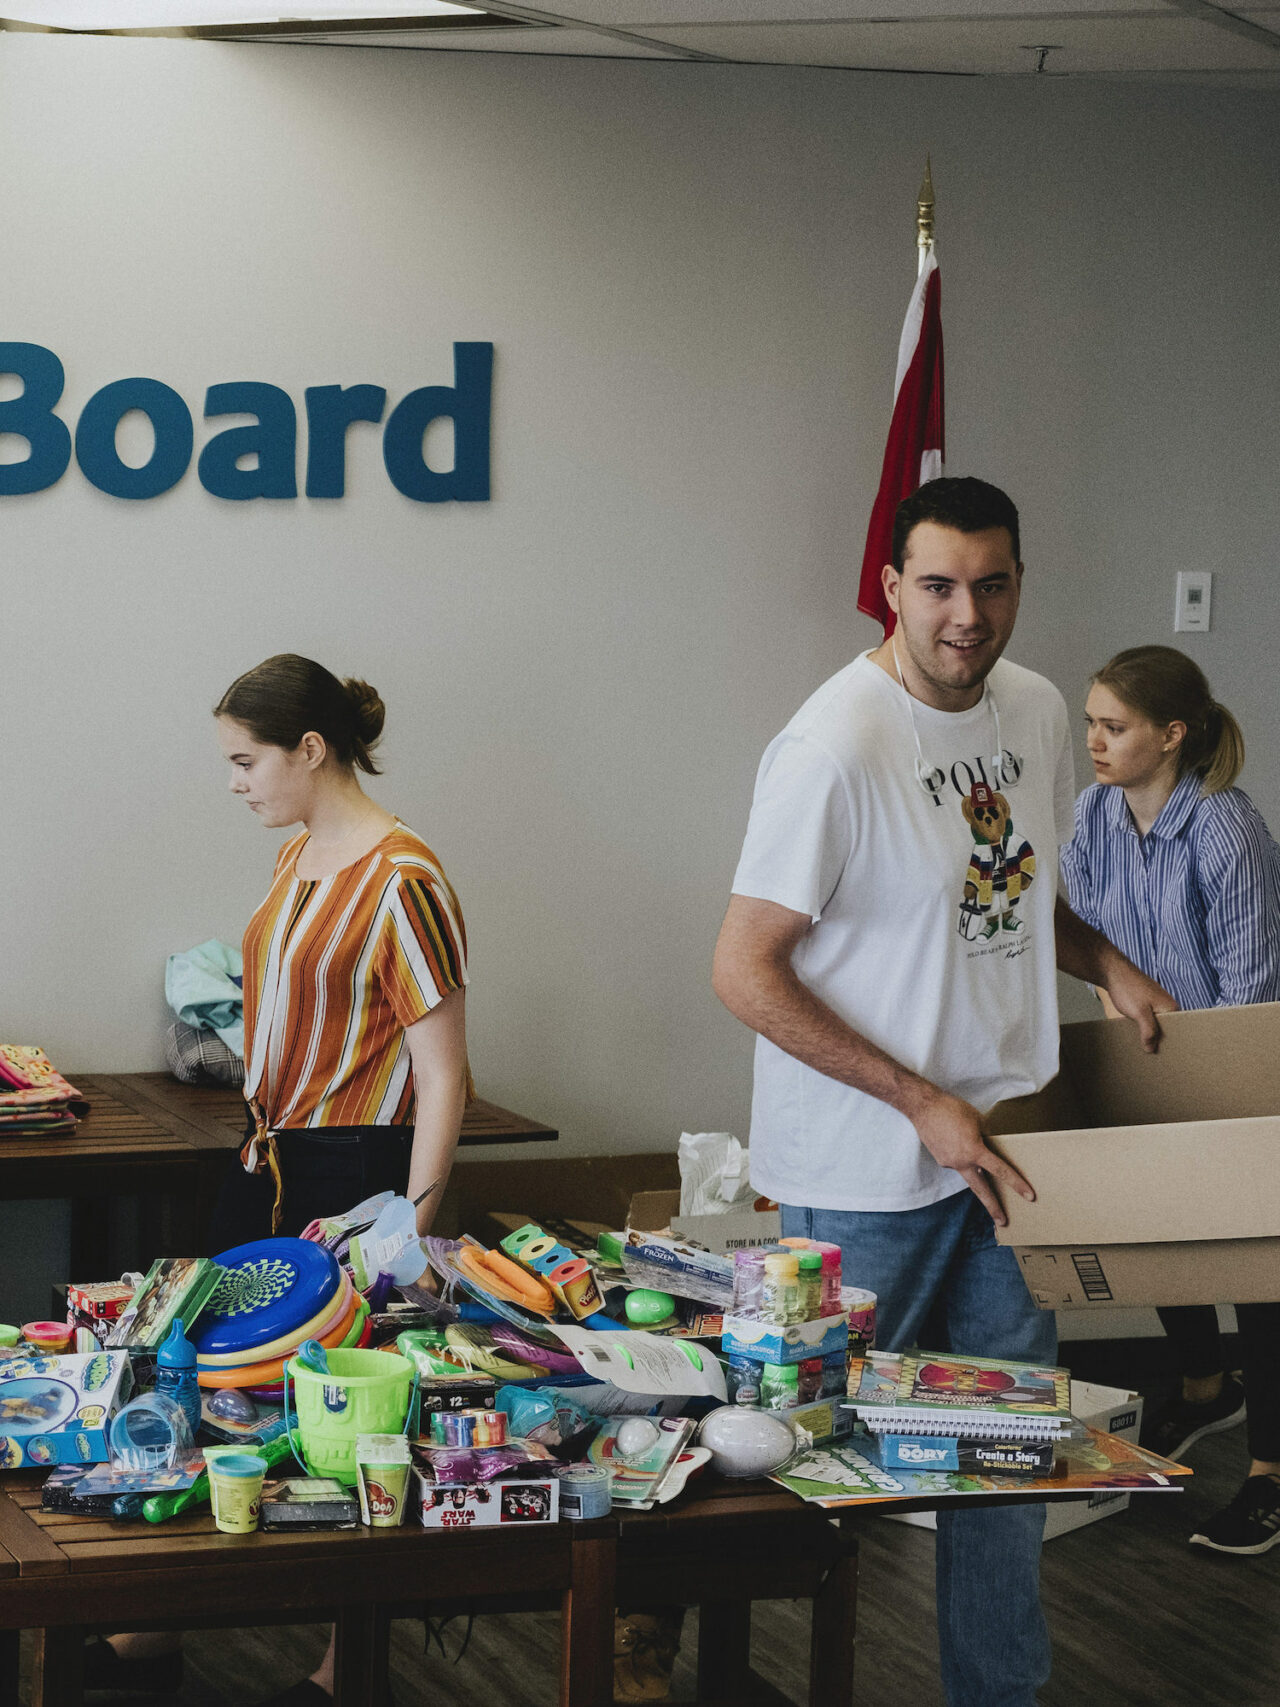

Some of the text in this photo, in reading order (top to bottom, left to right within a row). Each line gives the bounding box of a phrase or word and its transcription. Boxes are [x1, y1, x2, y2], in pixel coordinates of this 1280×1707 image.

[923, 749, 1021, 807] POLO
[725, 1239, 747, 1248] STORE
[748, 1238, 757, 1247] IN
[756, 1238, 762, 1247] A
[643, 1247, 675, 1262] FROZEN
[449, 1396, 463, 1407] 12
[898, 1448, 949, 1461] DORY
[976, 1449, 1041, 1466] Create a Story
[1022, 1462, 1033, 1471] Set
[442, 1509, 476, 1518] WARS
[441, 1516, 476, 1526] STAR
